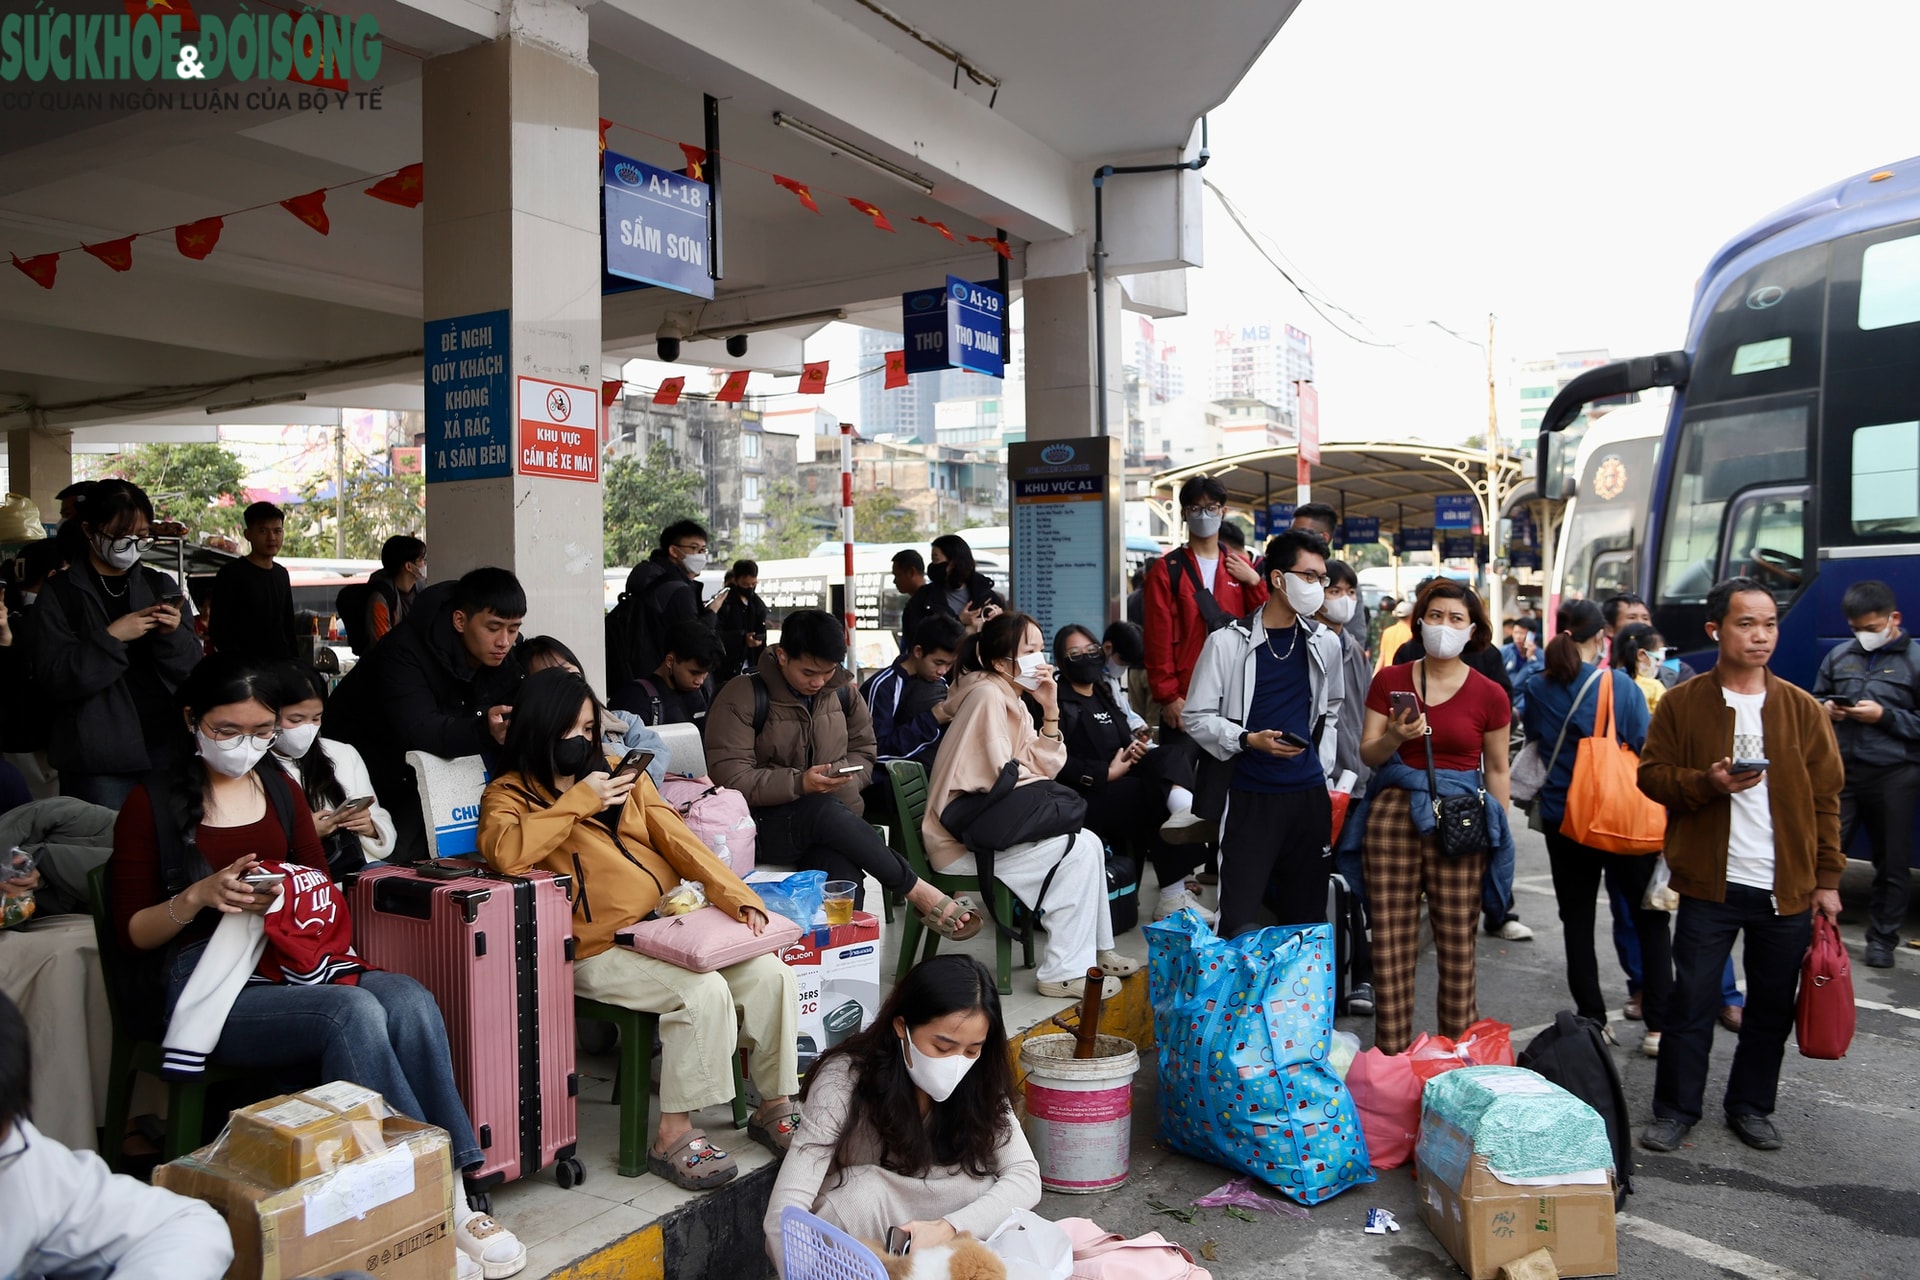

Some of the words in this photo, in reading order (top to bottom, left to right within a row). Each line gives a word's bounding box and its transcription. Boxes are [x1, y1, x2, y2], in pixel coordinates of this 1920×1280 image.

[648, 174, 701, 208] A1-18
[620, 215, 661, 255] SẦM
[667, 233, 702, 266] SƠN
[970, 290, 998, 312] A1-19
[441, 323, 457, 352] ĐỀ
[462, 326, 493, 349] NGHỊ
[914, 331, 943, 352] THỌ
[955, 324, 973, 351] THỌ
[975, 331, 999, 355] XUÂN
[1242, 326, 1270, 341] MB
[460, 351, 503, 379] KHÁCH
[445, 385, 489, 410] KHÔNG
[444, 414, 461, 439] XẢ
[465, 412, 490, 437] RÁC
[537, 428, 558, 444] KHU
[561, 432, 581, 448] VỰC
[450, 443, 476, 468] SÂN
[480, 436, 506, 466] BẾN
[523, 445, 544, 467] CẤM
[547, 447, 558, 469] ĐỂ
[560, 454, 572, 470] XE
[574, 452, 594, 473] MÁY
[1025, 482, 1048, 493] KHU
[1051, 480, 1076, 494] VỰC
[1078, 480, 1093, 490] A1
